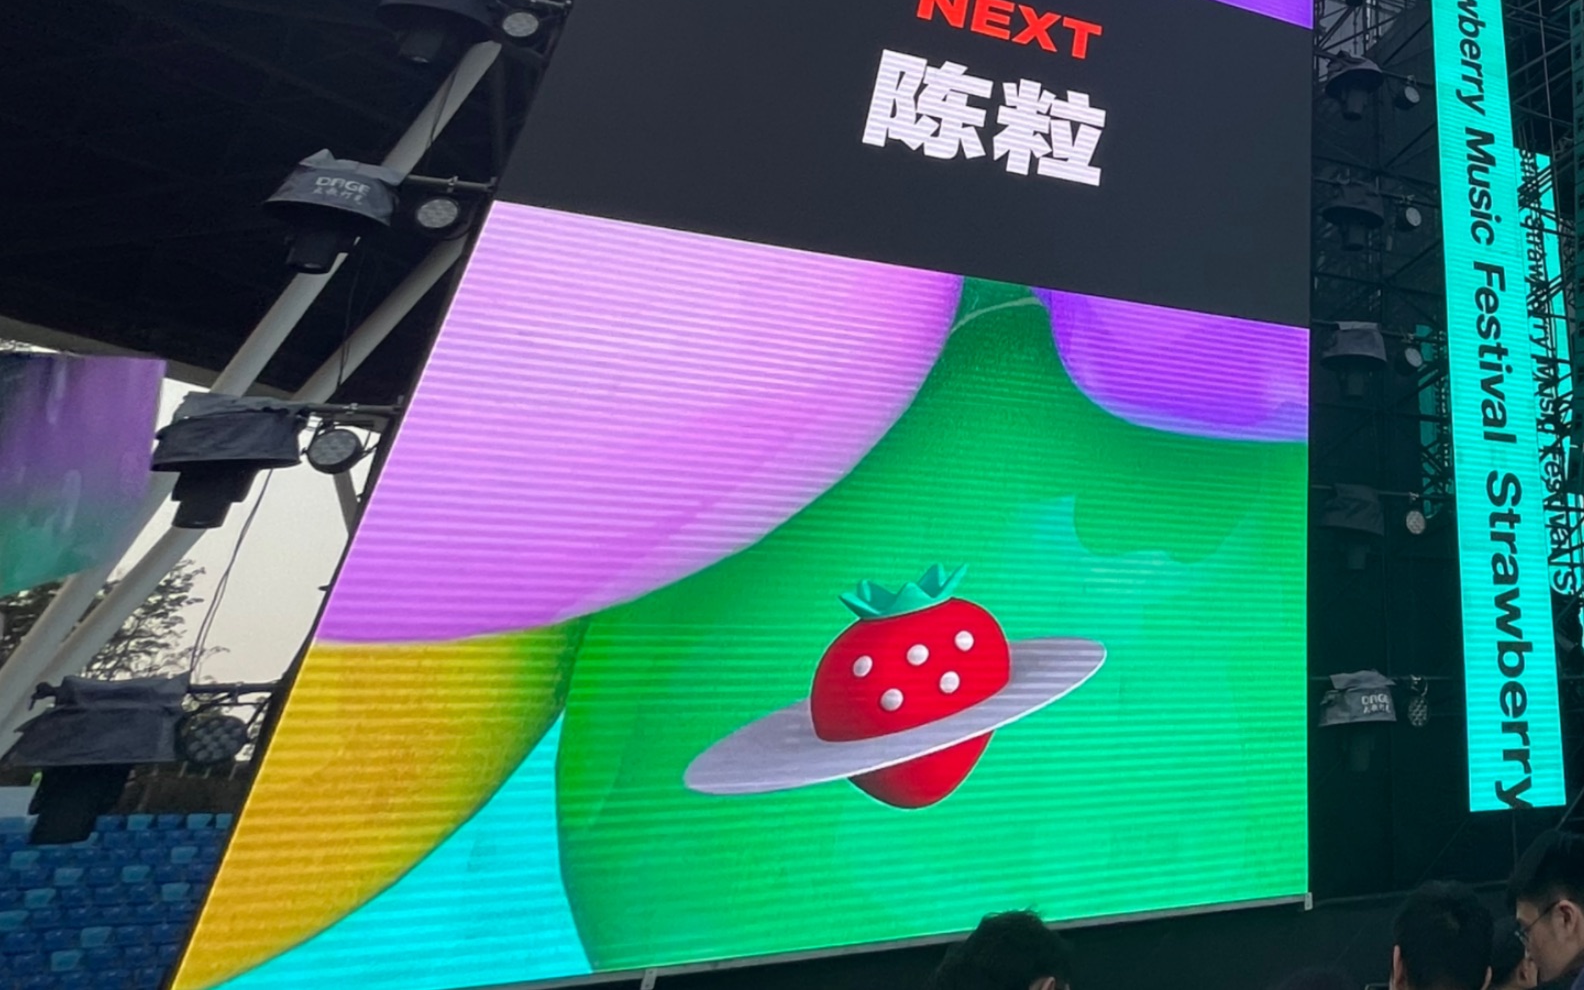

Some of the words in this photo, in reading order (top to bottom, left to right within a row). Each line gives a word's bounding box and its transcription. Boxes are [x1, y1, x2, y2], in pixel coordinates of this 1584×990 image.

[862, 49, 1107, 186] 陈粒
[1465, 126, 1504, 247] Music
[1473, 261, 1517, 444] Festival
[1485, 470, 1534, 809] Strawberry
